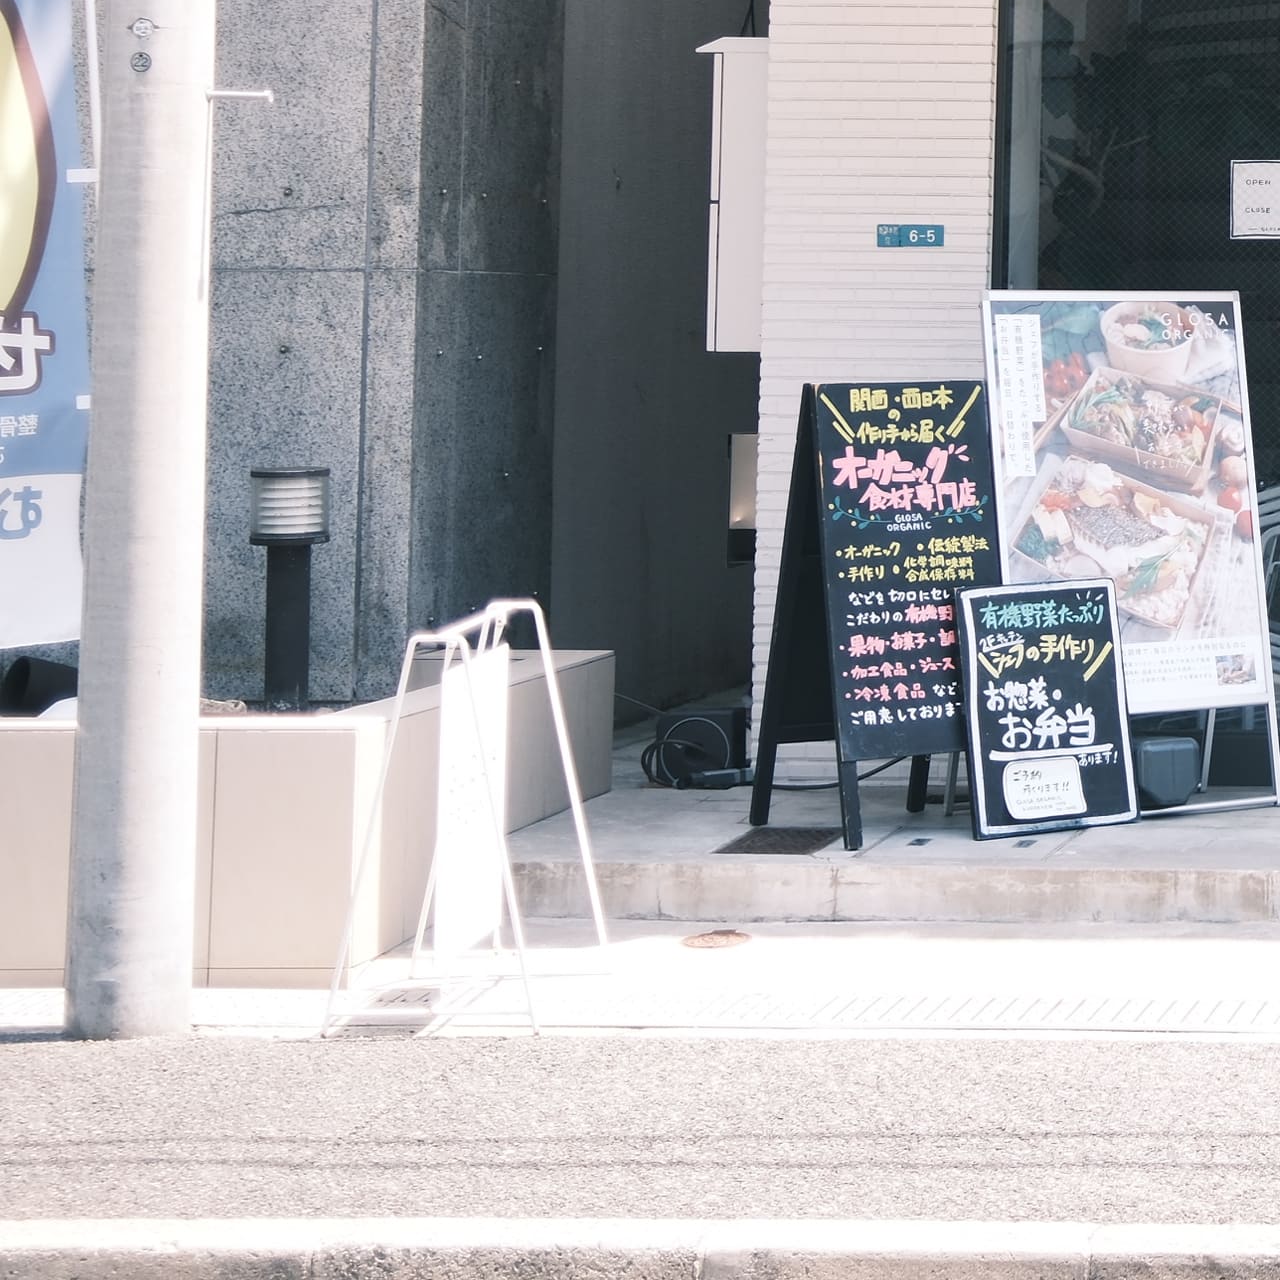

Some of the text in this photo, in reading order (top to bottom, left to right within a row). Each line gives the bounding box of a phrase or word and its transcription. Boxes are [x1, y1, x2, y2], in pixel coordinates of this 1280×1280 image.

[909, 229, 936, 243] 6-5
[1160, 311, 1230, 326] GLOSA
[849, 384, 954, 413] 関西・西日本
[888, 408, 901, 422] の
[856, 418, 946, 445] 作り手から届く
[832, 444, 967, 489] オーガニック
[858, 477, 977, 512] 食材専門店
[886, 521, 933, 532] ORGANIC
[894, 512, 924, 523] GLOSA
[844, 535, 990, 561] オーガニック 伝統製法
[903, 555, 975, 569] 化学調味料
[847, 564, 886, 583] 手作り
[904, 567, 976, 583] 合成保存料
[979, 599, 1105, 630] 有機野菜たっぷり
[989, 633, 1095, 673] シェフの手作り
[850, 656, 956, 681] 加工食品・ジュース
[853, 682, 926, 702] 冷凍食品
[998, 702, 1096, 750] お弁当
